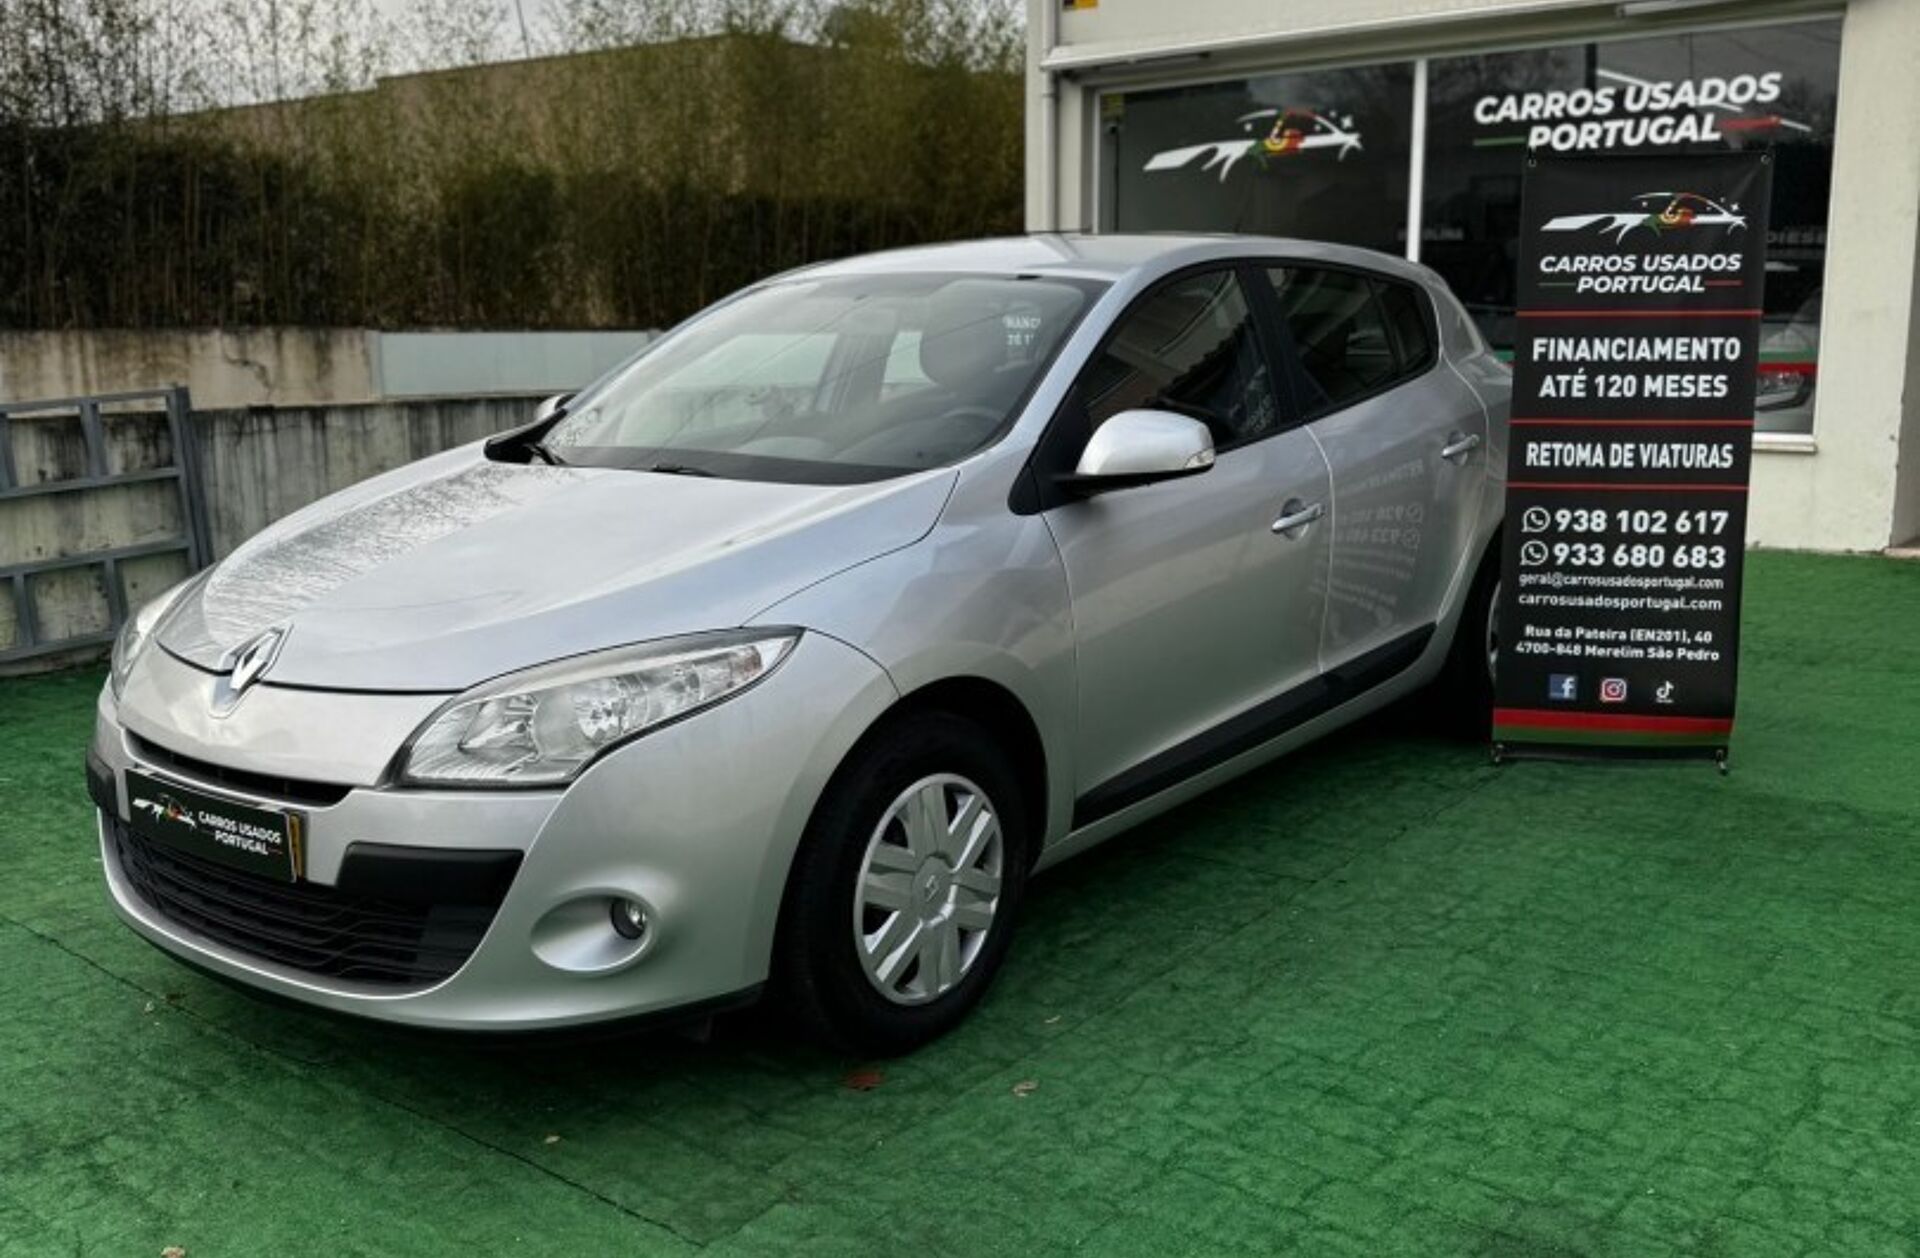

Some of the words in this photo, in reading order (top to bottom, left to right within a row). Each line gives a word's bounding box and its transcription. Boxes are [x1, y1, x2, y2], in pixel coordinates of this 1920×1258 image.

[1473, 87, 1614, 124] CARROS
[1623, 72, 1782, 110] USADOS
[1528, 114, 1721, 151] PORTUGAL
[1540, 256, 1636, 272] CARROS
[1643, 254, 1742, 270] USADOS
[1577, 275, 1705, 293] PORTUGAL
[1533, 337, 1741, 361] FINANCIAMENTO
[1539, 368, 1586, 398] ATÉ
[1595, 375, 1637, 398] 120
[1643, 375, 1728, 398] MESES
[1526, 442, 1605, 467] RETOMA
[1609, 444, 1635, 468] DE
[1639, 444, 1734, 468] VIATURAS
[1555, 510, 1608, 533] 938
[1616, 511, 1667, 534] 102
[1674, 511, 1729, 535] 617
[1553, 543, 1605, 566] 933
[1612, 545, 1665, 568] 680
[1672, 546, 1726, 569] 683
[1518, 594, 1722, 611] carrosusadosportugal.com
[1525, 625, 1551, 637] Rua
[1554, 627, 1572, 638] da
[1694, 631, 1713, 643] 40
[1677, 648, 1720, 661] Pedro
[198, 811, 237, 832] CARROS
[239, 822, 282, 844] USADOS
[215, 830, 269, 856] PORTUGAL
